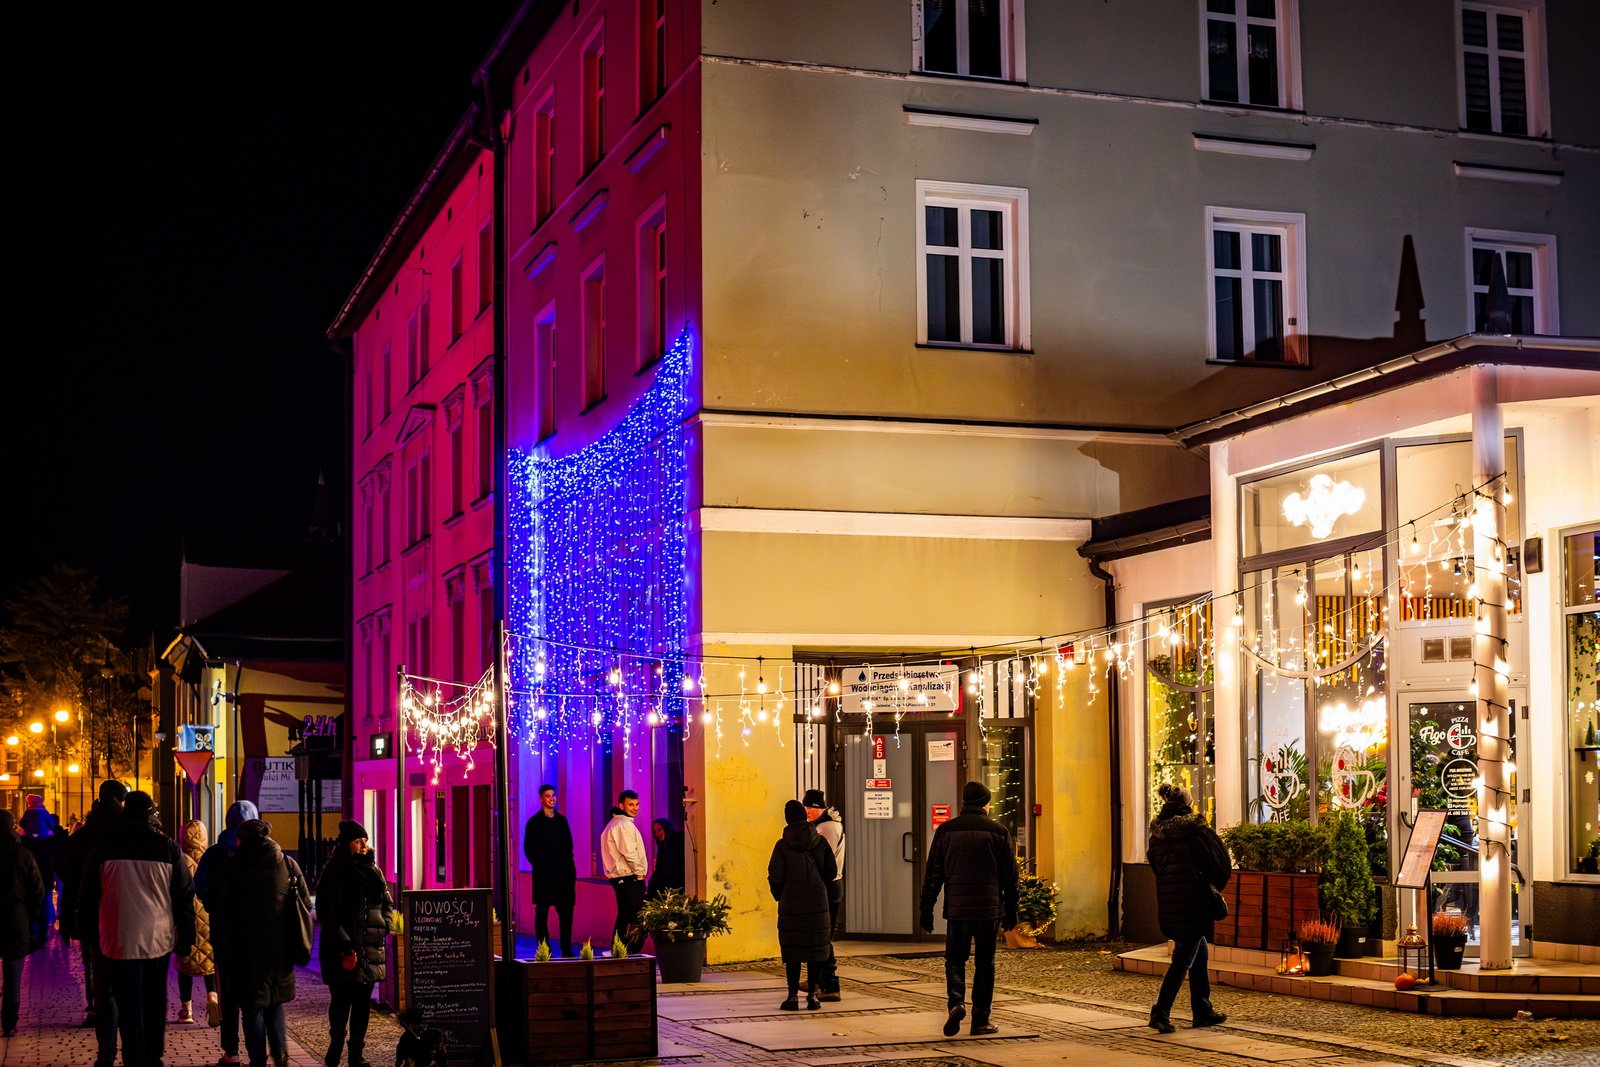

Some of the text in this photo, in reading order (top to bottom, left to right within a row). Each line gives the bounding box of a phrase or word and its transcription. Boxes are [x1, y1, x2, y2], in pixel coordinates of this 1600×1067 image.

[906, 681, 951, 692] analizacji
[1451, 716, 1469, 724] PIZZA
[1420, 726, 1446, 745] Figo
[254, 762, 294, 771] BUTIK
[1269, 809, 1290, 824] AFE
[1338, 808, 1365, 824] CFE
[415, 897, 474, 916] NOWOŚCI
